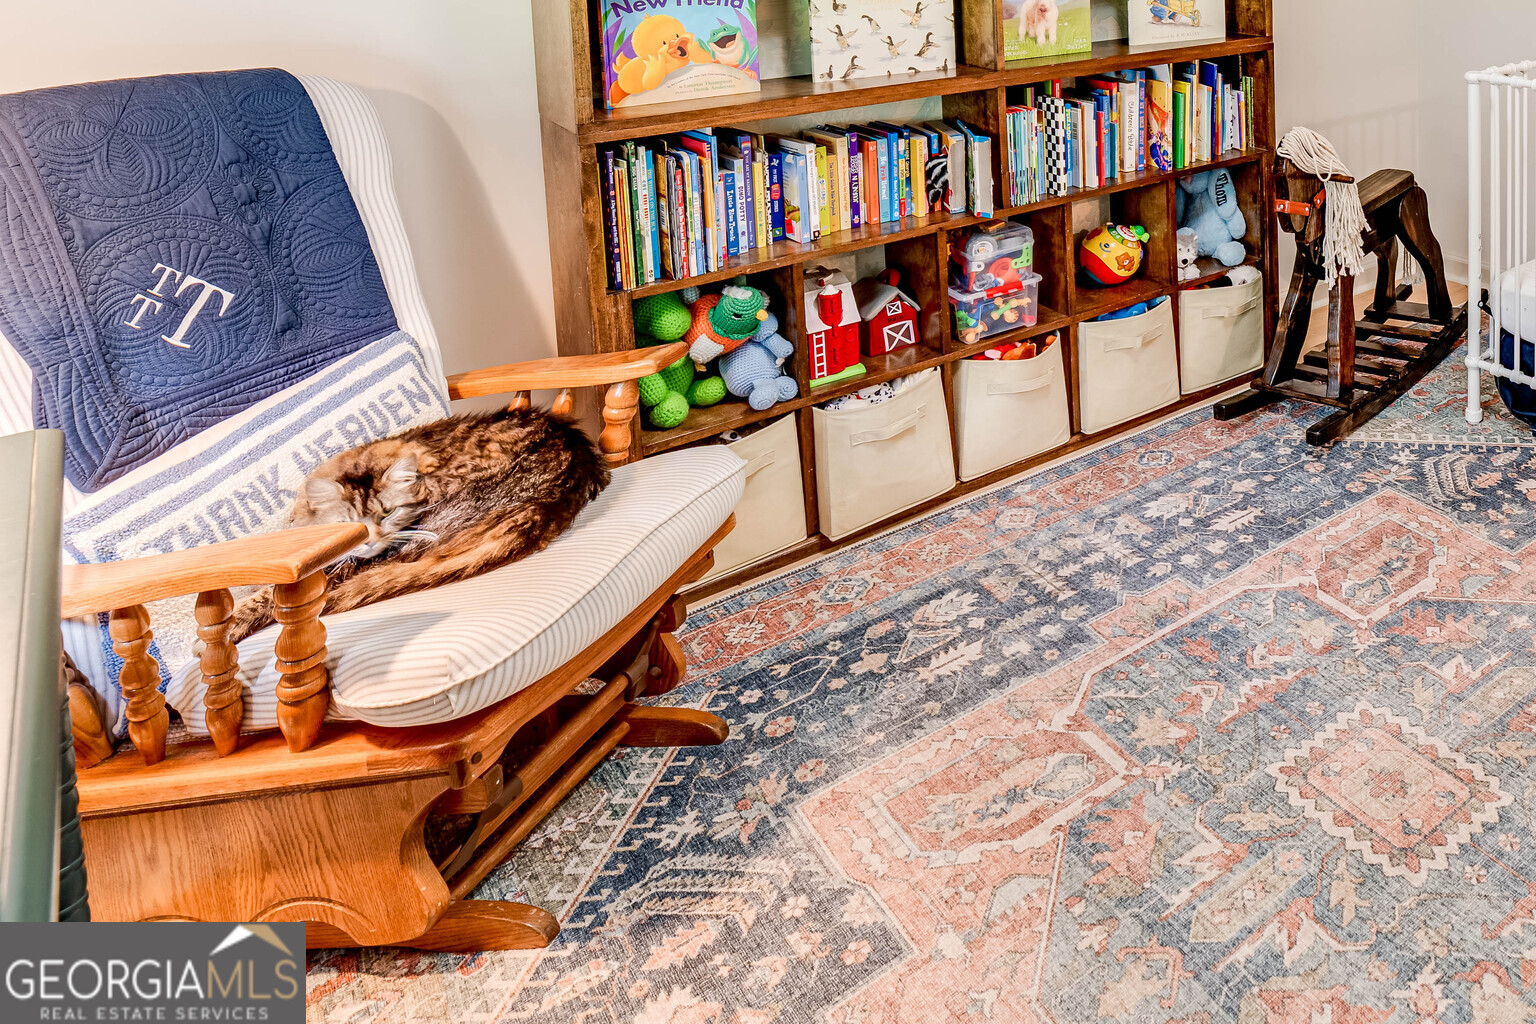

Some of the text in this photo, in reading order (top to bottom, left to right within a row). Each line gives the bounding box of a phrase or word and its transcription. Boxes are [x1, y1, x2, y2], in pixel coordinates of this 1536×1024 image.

[152, 262, 182, 297] T
[124, 294, 163, 329] T
[161, 274, 235, 349] T
